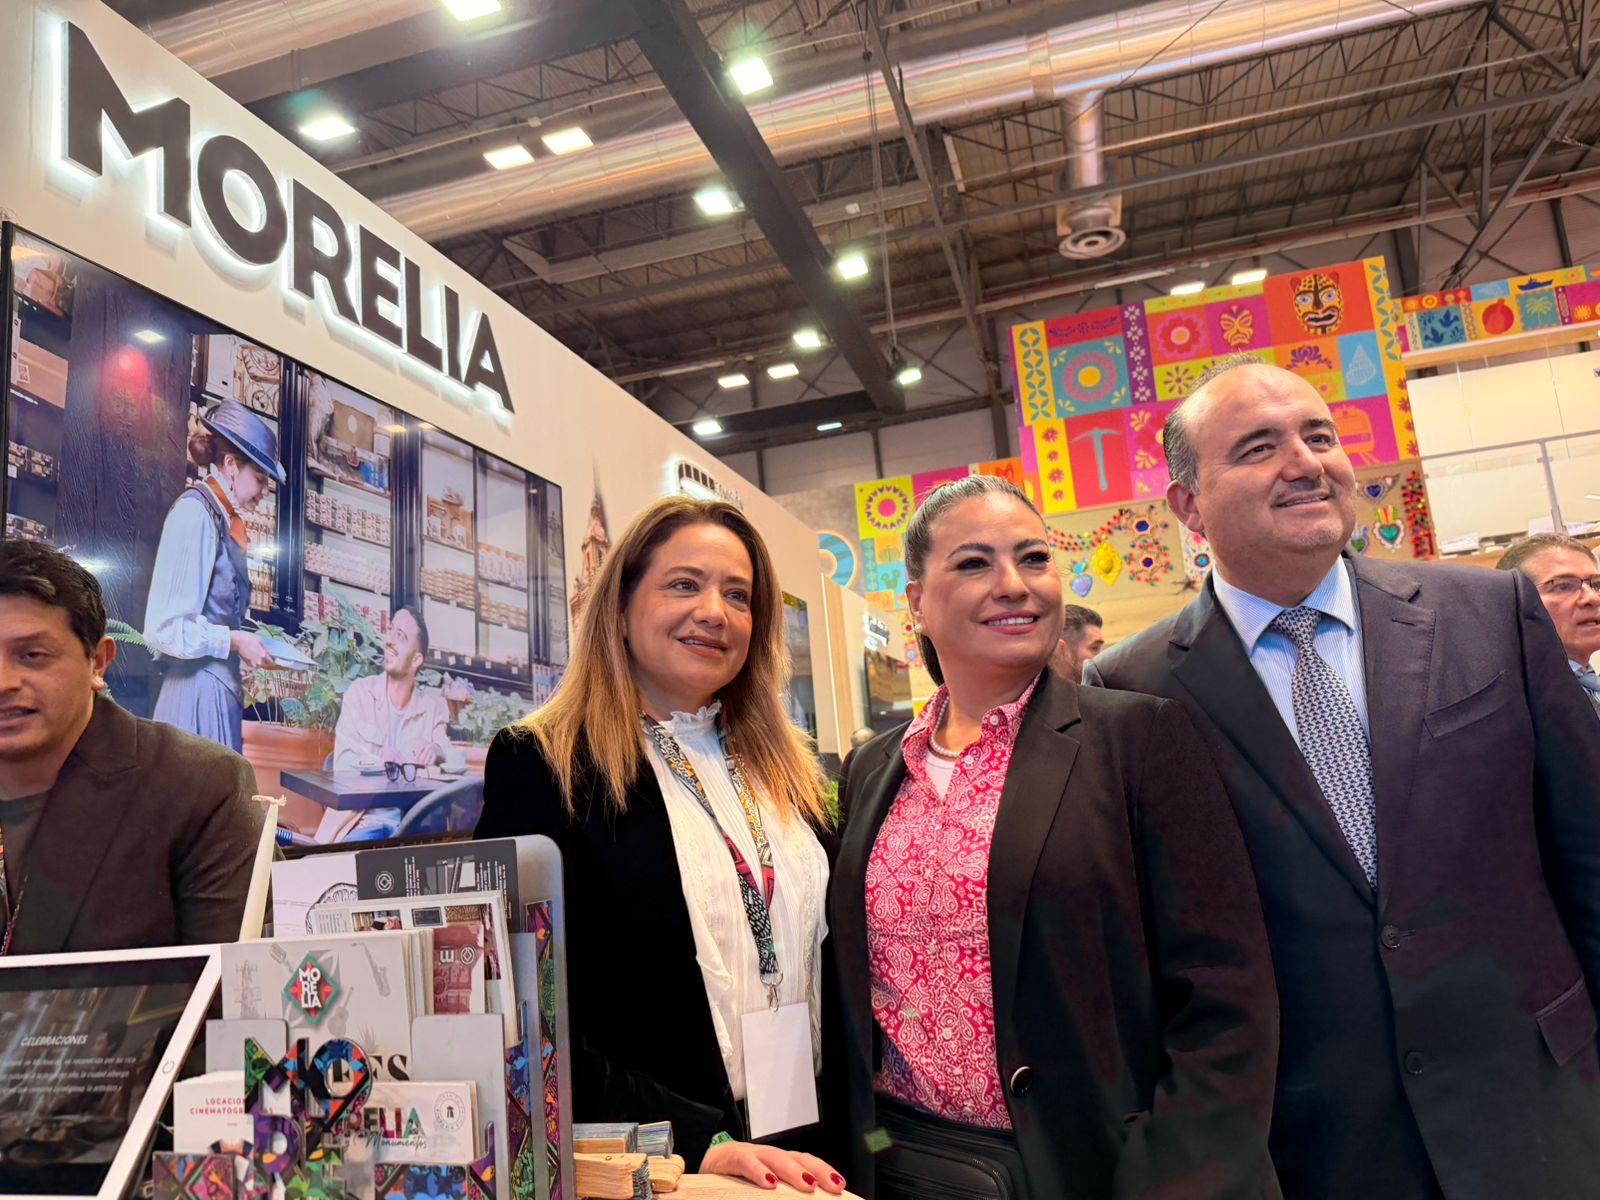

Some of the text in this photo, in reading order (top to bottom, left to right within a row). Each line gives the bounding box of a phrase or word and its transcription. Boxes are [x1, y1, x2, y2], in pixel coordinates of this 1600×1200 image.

[64, 21, 516, 413] MORELIA
[299, 968, 320, 983] MO
[302, 981, 318, 995] RE
[301, 992, 322, 1009] LIA
[21, 1034, 88, 1046] CELEBRACIONES
